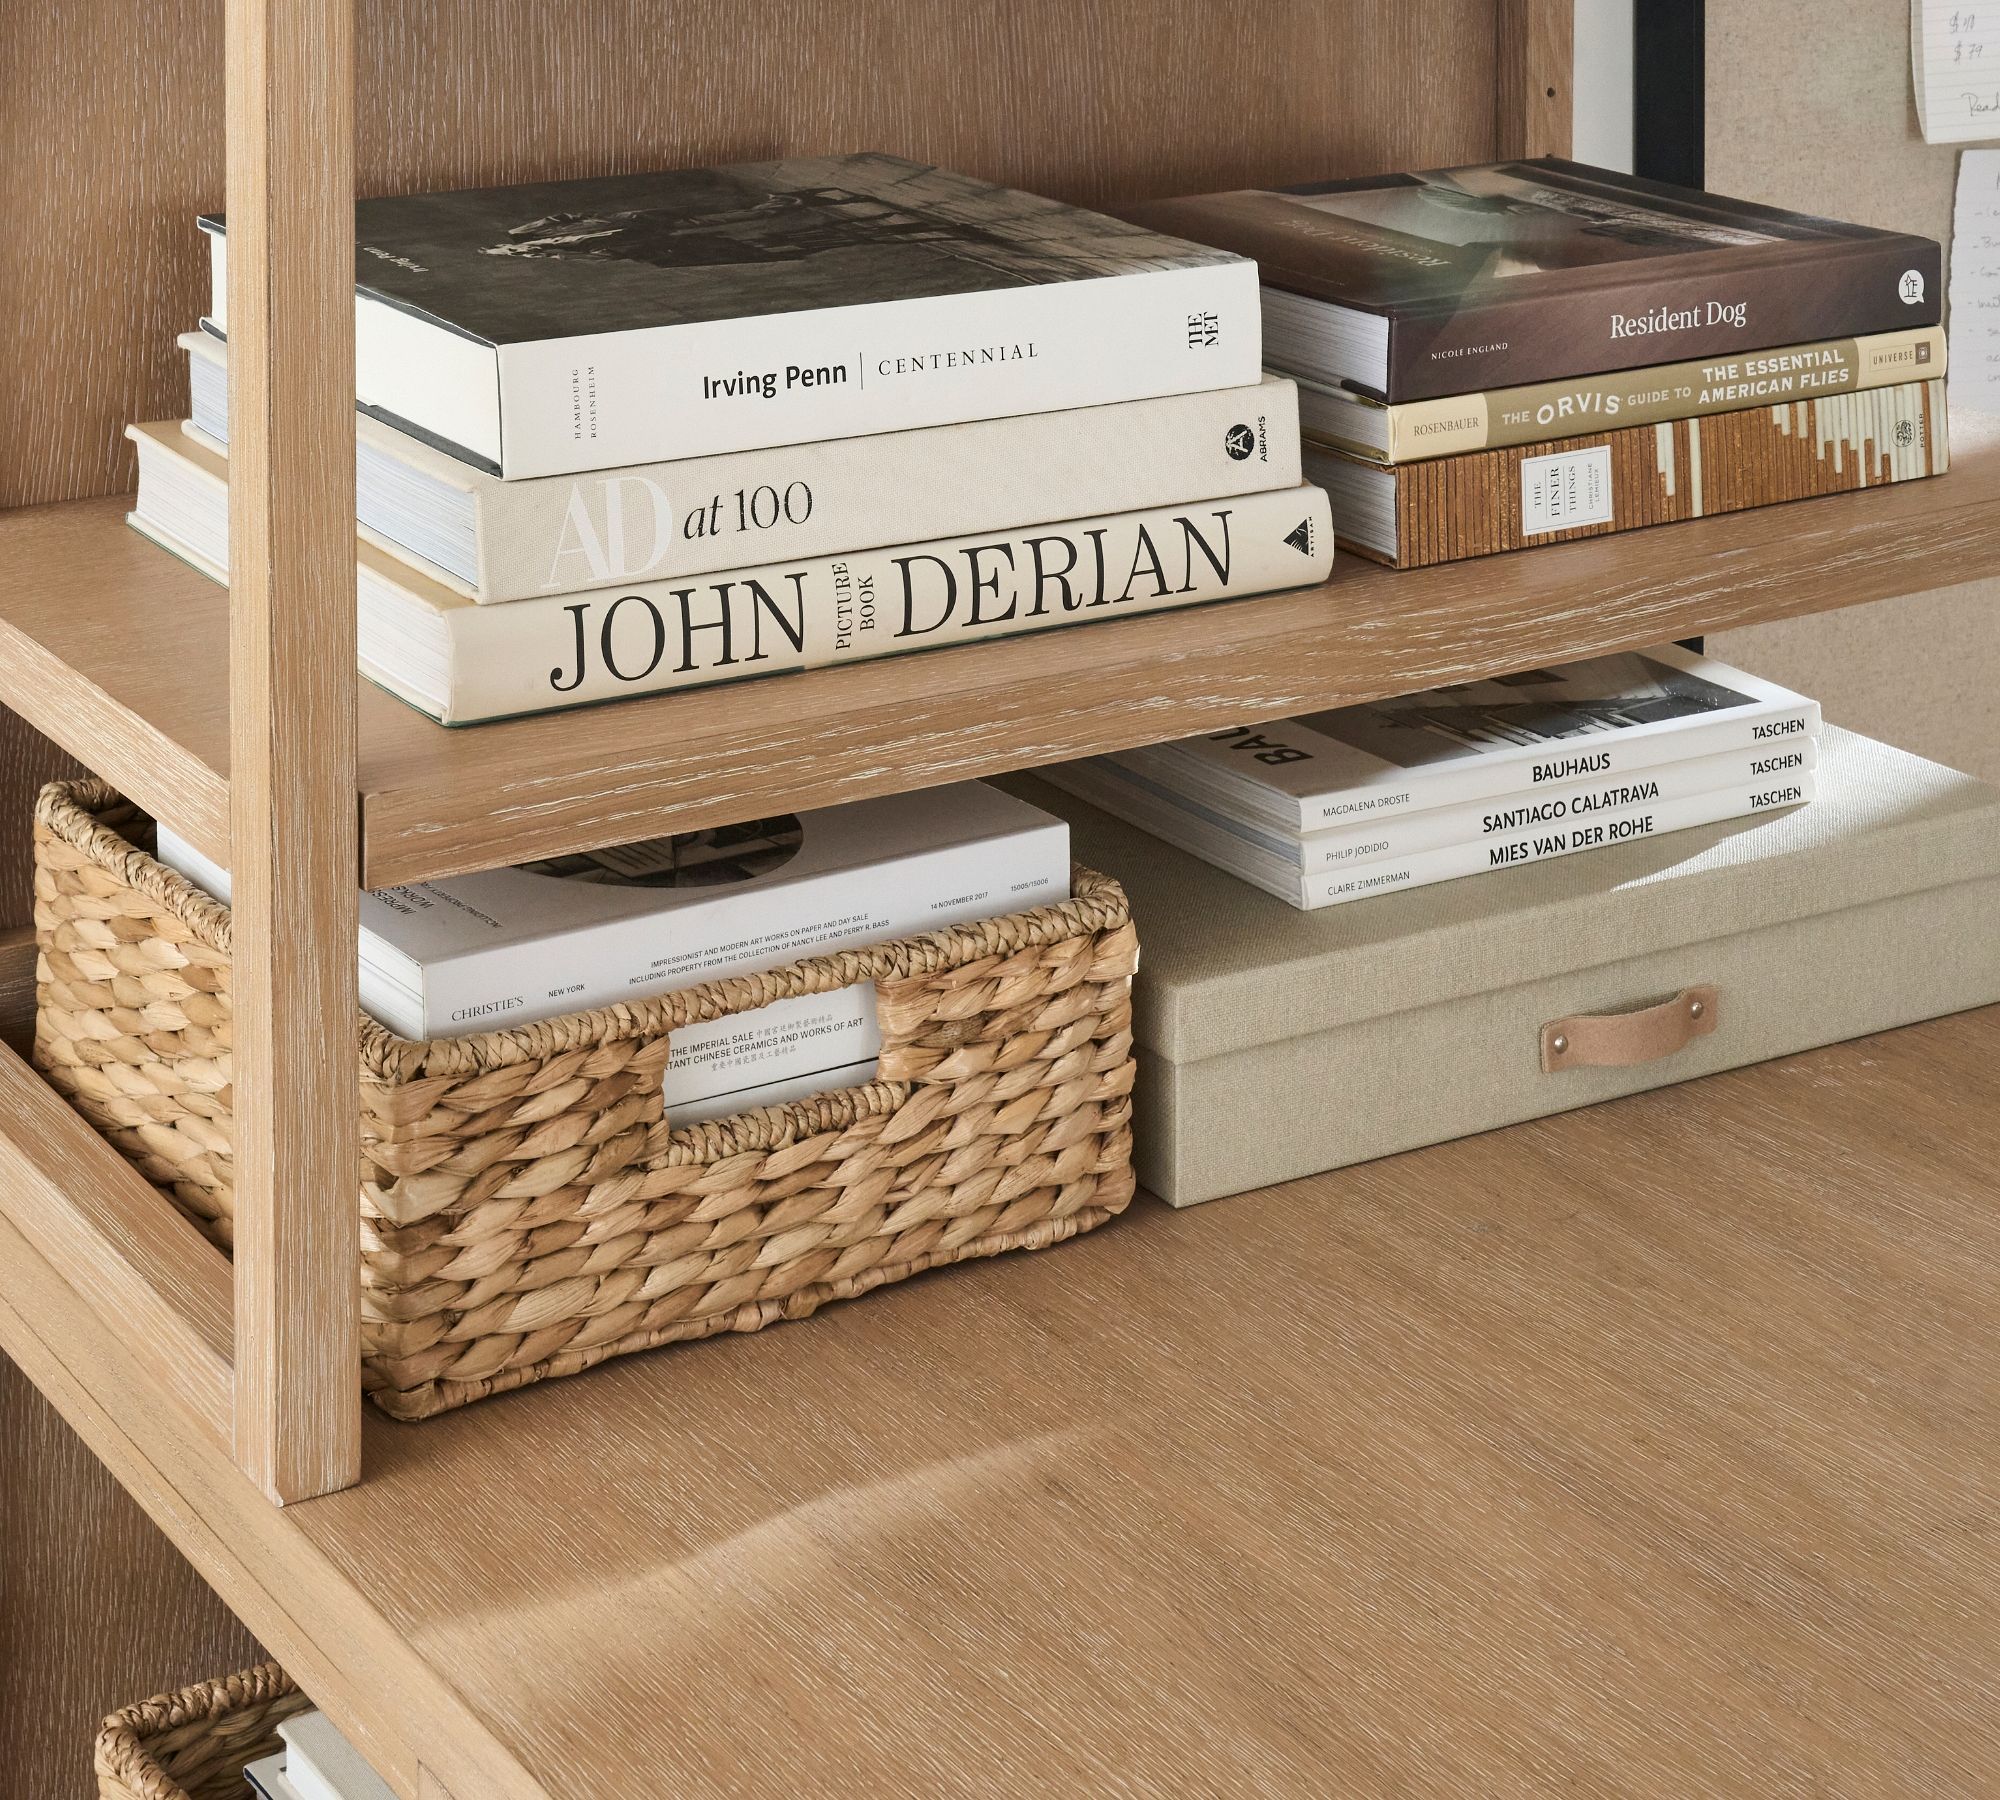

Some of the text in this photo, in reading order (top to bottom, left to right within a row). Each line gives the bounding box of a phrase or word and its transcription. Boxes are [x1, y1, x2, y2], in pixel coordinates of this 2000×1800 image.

[1188, 313, 1203, 349] THE
[1203, 311, 1219, 347] MET
[1610, 301, 1747, 339] Resident Dog
[1431, 342, 1509, 360] NICOLE ENGLAND
[1702, 349, 1844, 383] THE ESSENTIAL
[1873, 350, 1913, 365] UNIVERSE
[703, 343, 1040, 400] Irving Penn CENTENNIAL
[1698, 368, 1849, 404] AMERICAN FLIES
[573, 367, 582, 439] HAMBOURG
[588, 365, 598, 439] ROSENHEIM
[1502, 386, 1692, 426] THE ORVIS GUIDE TO
[1258, 416, 1268, 462] ABRAMS
[1413, 417, 1479, 437] ROSENBAUER
[1550, 467, 1560, 516] FINER
[1569, 465, 1577, 513] THINGS
[540, 476, 813, 589] AD at 100
[550, 510, 1233, 692] JOHN DERIAN
[832, 562, 851, 650] PICTURE
[859, 575, 875, 631] BOOK
[1752, 718, 1805, 740] TASCHEN
[1532, 753, 1610, 782] BAUHAUS
[1750, 753, 1803, 776] TASCHEN
[1323, 793, 1410, 817] MAGDALENA DROSTE
[1482, 783, 1659, 833] SANTIAGO CALATRAVA
[1749, 787, 1802, 809] TASCHEN
[1325, 841, 1389, 862] PHILIP JODIDIO
[1489, 816, 1654, 867] MIES VAN DER ROHE
[938, 895, 974, 909] NOVEMBER
[974, 892, 988, 900] 2017
[1010, 877, 1049, 892] 15005/15006
[1327, 872, 1410, 895] CLAIRE ZIMMERMAN
[629, 971, 667, 985] INCLUDING
[667, 962, 702, 976] PROPERTY
[703, 957, 723, 967] FROM
[724, 955, 737, 963] THE
[738, 945, 780, 959] COLLECTION
[791, 937, 815, 947] NANCY
[815, 934, 827, 942] LEE
[828, 930, 843, 939] AND
[843, 925, 864, 935] PERRY
[872, 919, 890, 929] BASS
[651, 913, 869, 968] IMPRESSIONIST AND MODERN ART WORKS ON PAPER AND DAY SALE
[451, 983, 585, 1023] CHRISTIE'S NEW YORK
[666, 1018, 864, 1070] TANT CHINESE CERAMICS AND WORKS OF ART
[671, 1032, 754, 1058] THE IMPERIAL SALE
